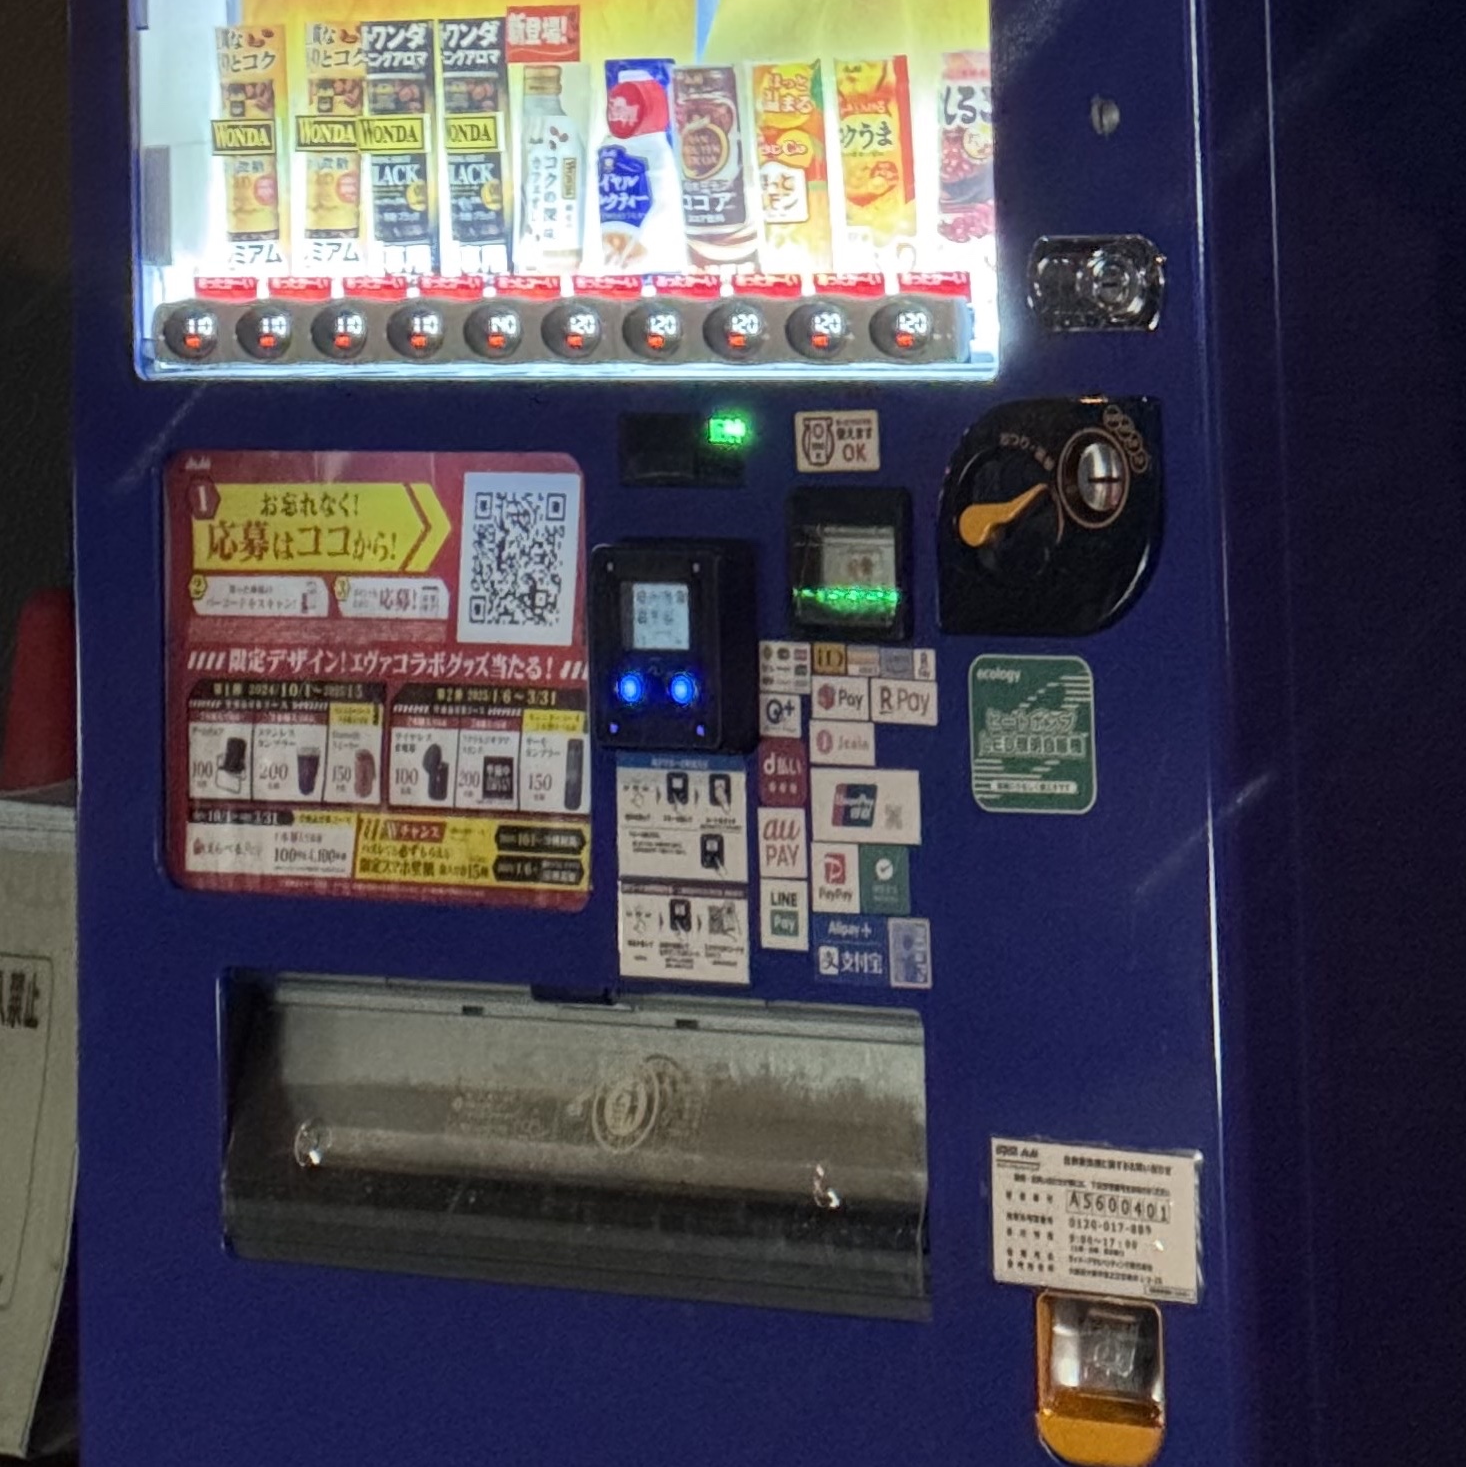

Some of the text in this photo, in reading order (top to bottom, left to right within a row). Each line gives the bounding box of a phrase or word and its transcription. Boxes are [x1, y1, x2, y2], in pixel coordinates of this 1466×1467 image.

[214, 122, 271, 150] WONDA
[299, 118, 357, 146] WONDA
[361, 118, 419, 144] WONDA
[842, 443, 867, 463] OK
[260, 492, 361, 518] お忘れなく!
[205, 519, 399, 564] 応募はココから!
[976, 666, 1022, 684] ecology
[838, 688, 864, 711] Pay
[897, 686, 931, 716] Pay
[191, 760, 214, 780] 100
[258, 763, 289, 781] 200
[395, 767, 419, 786] 100
[528, 773, 553, 792] 150
[763, 818, 800, 841] au
[766, 844, 800, 868] PAY
[771, 891, 798, 908] LINE
[819, 887, 854, 902] PayPay
[773, 914, 796, 932] Pay
[840, 950, 884, 976] 支付宝
[1069, 1190, 1168, 1223] AS600401
